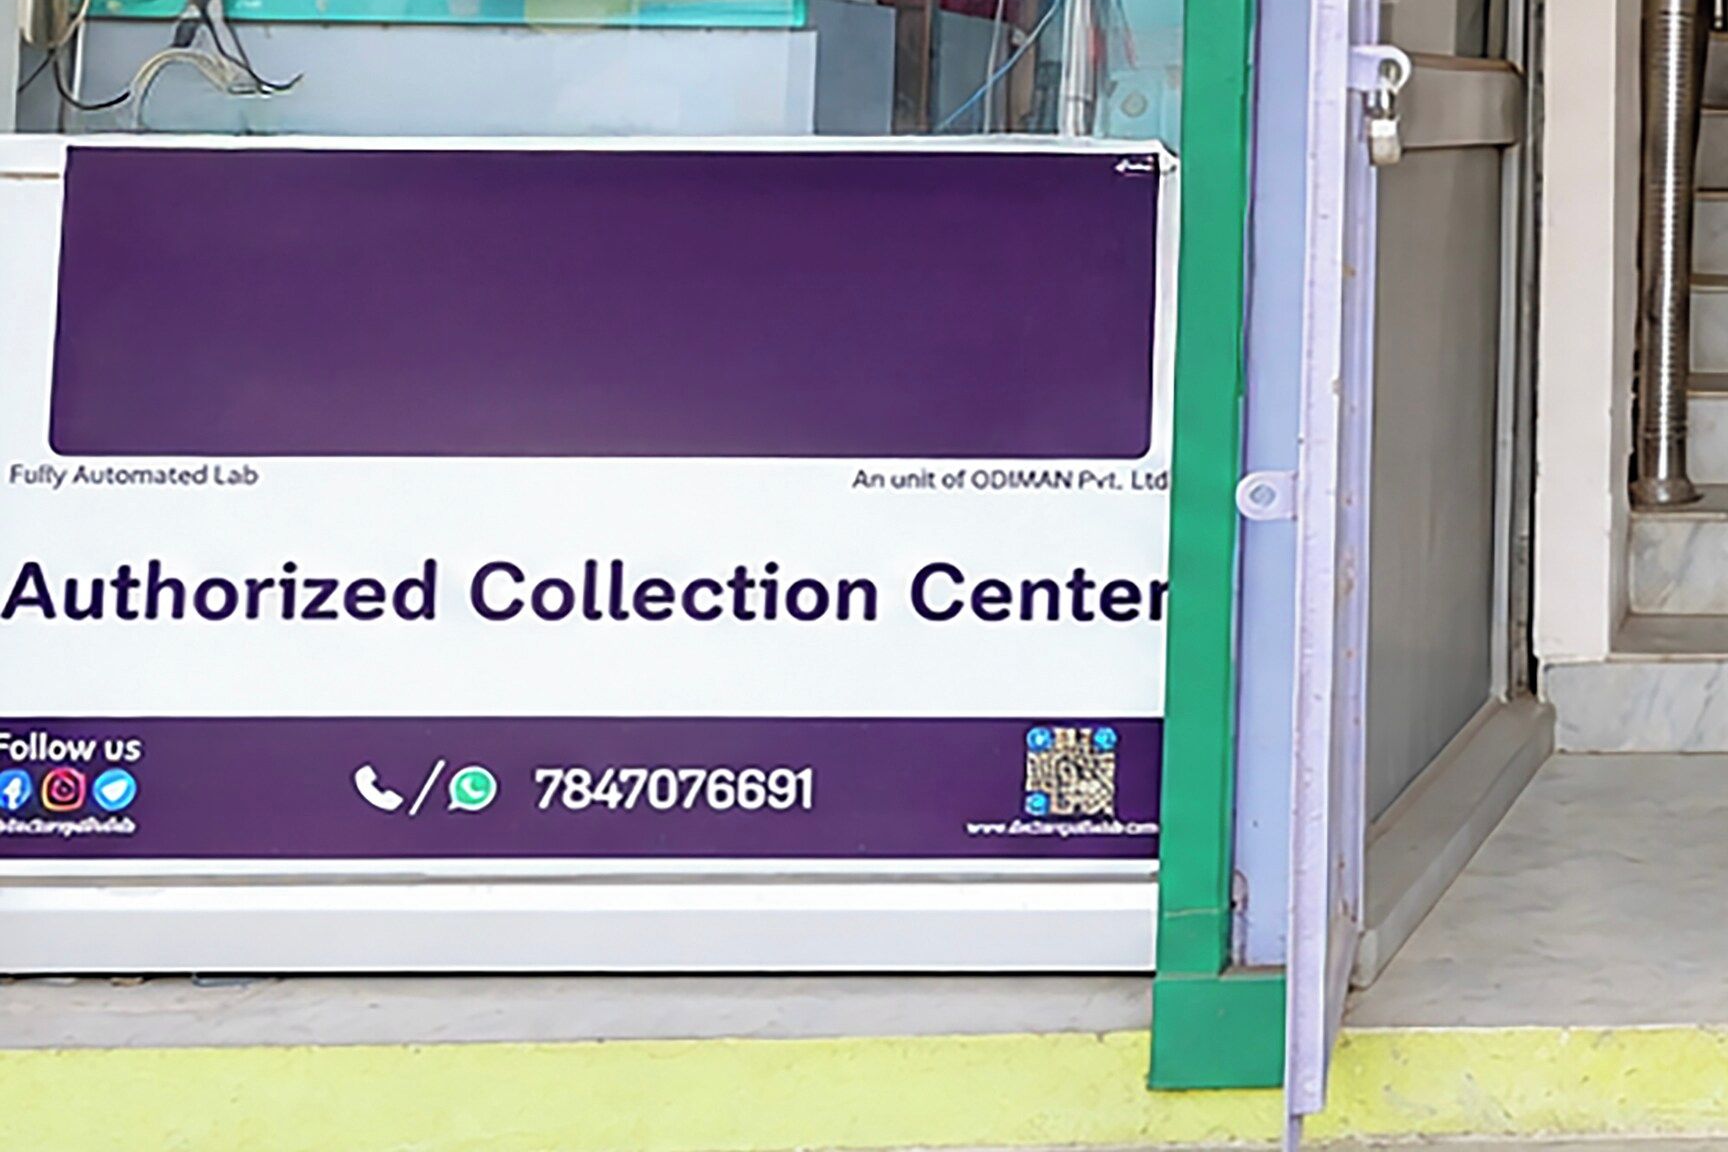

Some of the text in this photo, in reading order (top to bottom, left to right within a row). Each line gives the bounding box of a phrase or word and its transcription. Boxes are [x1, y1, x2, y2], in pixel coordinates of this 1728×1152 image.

[72, 464, 208, 486] Automated
[214, 464, 259, 486] Lab
[852, 468, 884, 489] An
[890, 467, 935, 489] unit
[941, 468, 967, 489] of
[0, 558, 1168, 622] Authorized Collection Center
[104, 739, 143, 761] us
[534, 767, 813, 810] 7847076691
